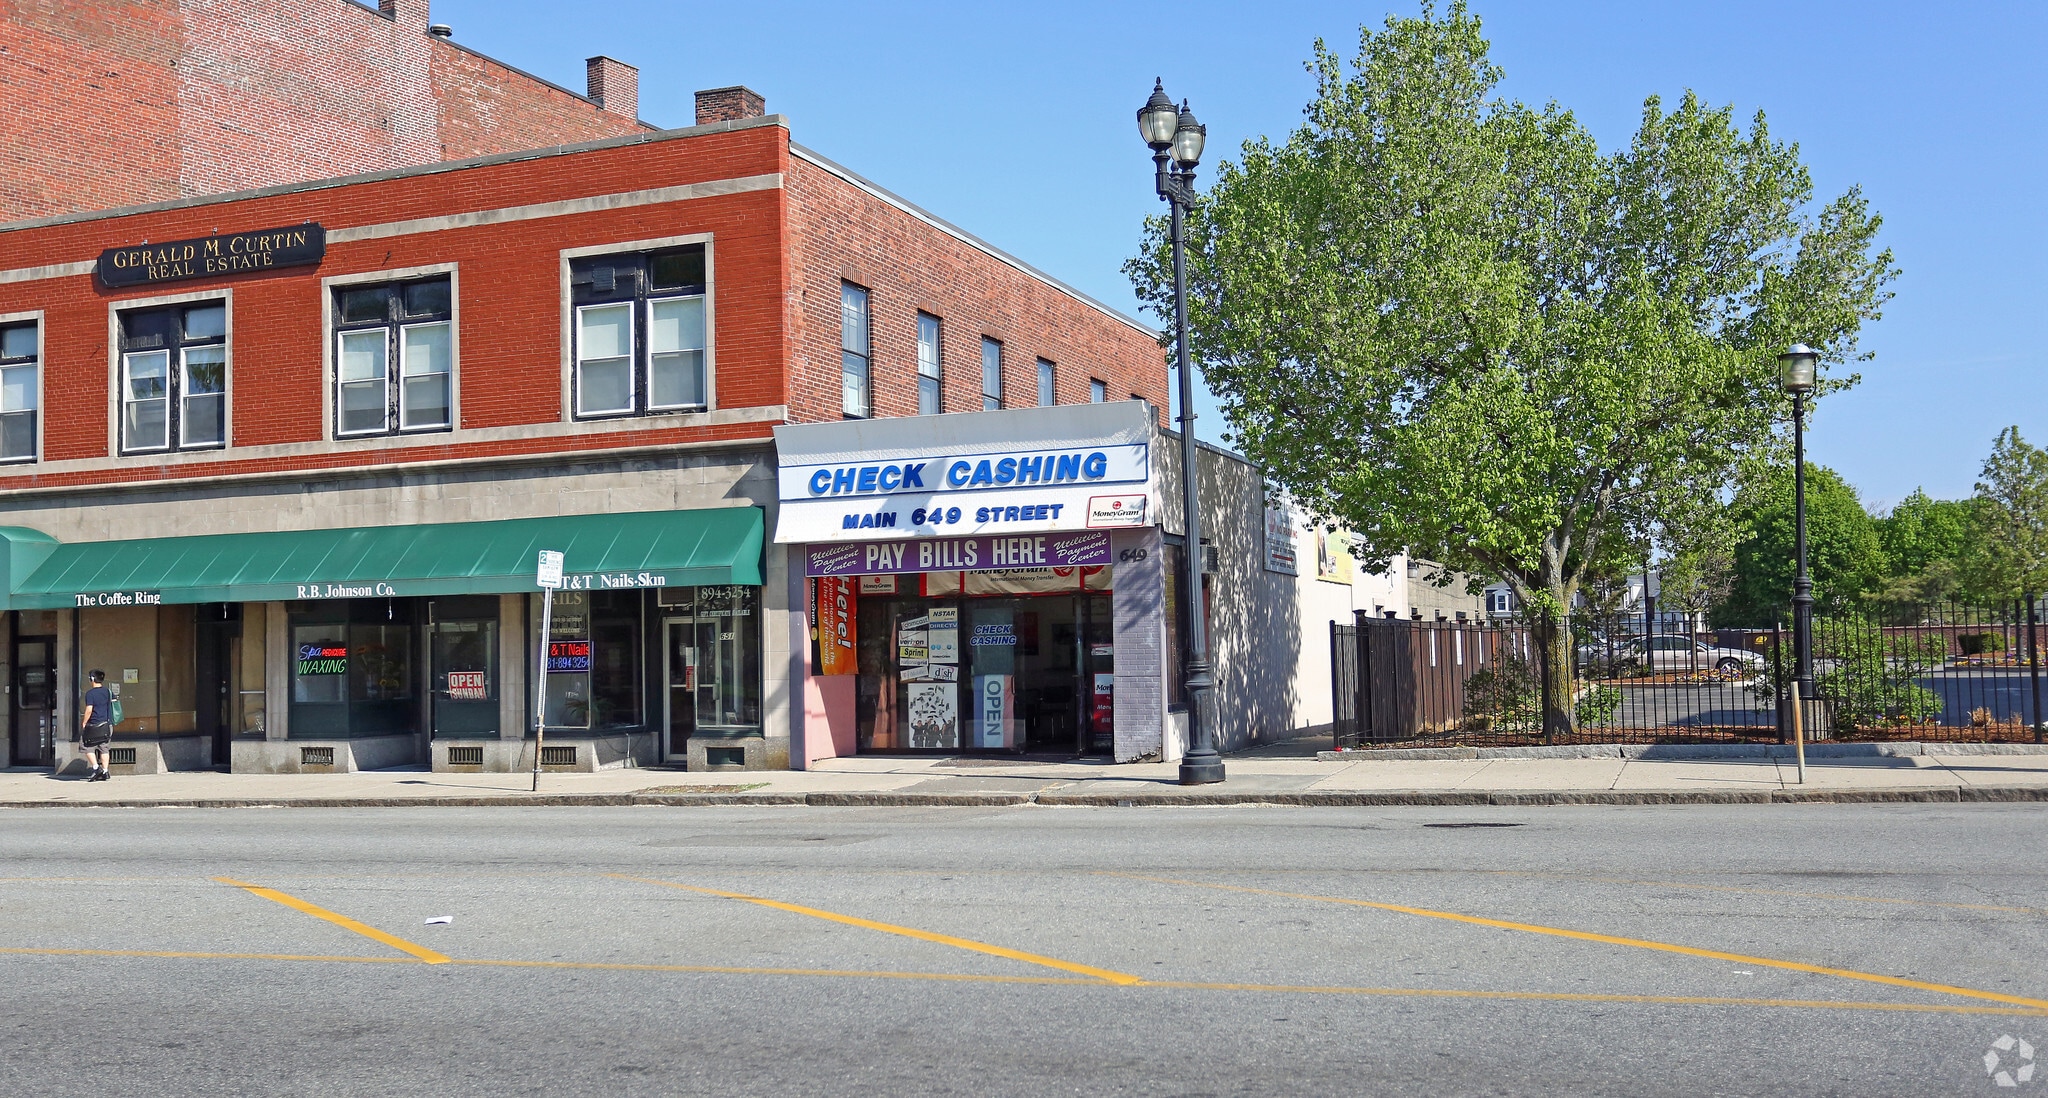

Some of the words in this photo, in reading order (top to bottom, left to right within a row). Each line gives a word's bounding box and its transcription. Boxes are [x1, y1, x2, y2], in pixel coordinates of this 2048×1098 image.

[114, 245, 194, 268] GERALD
[203, 240, 224, 258] M.
[230, 231, 306, 254] CURTIN
[148, 262, 194, 280] REAL
[206, 252, 273, 273] ESTATE
[809, 463, 926, 494] CHECK
[946, 452, 1107, 487] CASHING
[842, 511, 897, 529] MAIN
[911, 506, 961, 525] 649
[975, 504, 1064, 522] STREET
[1092, 510, 1139, 518] MoneyGram
[1053, 532, 1103, 550] Utilities
[1056, 538, 1108, 559] Payment
[810, 543, 855, 561] Utilities
[813, 549, 860, 569] Payment
[866, 543, 906, 570] PAY
[919, 540, 978, 569] BILLS
[992, 536, 1046, 565] HERE
[1067, 549, 1106, 564] Center
[1120, 548, 1148, 563] 649
[823, 560, 858, 574] Center
[562, 574, 593, 590] T&T
[296, 584, 322, 598] R.B.
[324, 584, 372, 598] Johnson
[376, 582, 396, 596] Co.
[701, 586, 751, 600] 894-3254
[75, 594, 96, 606] The
[98, 592, 132, 606] Coffee
[134, 592, 160, 605] Ring
[836, 575, 852, 649] Here!
[822, 616, 829, 624] of
[975, 625, 1012, 634] CHECK
[970, 635, 1016, 646] CASHING
[298, 645, 322, 660] Spa
[551, 644, 559, 656] &
[560, 644, 568, 656] T
[568, 644, 590, 656] Nails
[904, 648, 924, 657] Sprint
[298, 659, 346, 674] WAXING
[934, 667, 953, 679] dish
[450, 674, 482, 687] OPEN
[452, 688, 484, 699] SUNDAY
[986, 680, 1001, 736] OPEN
